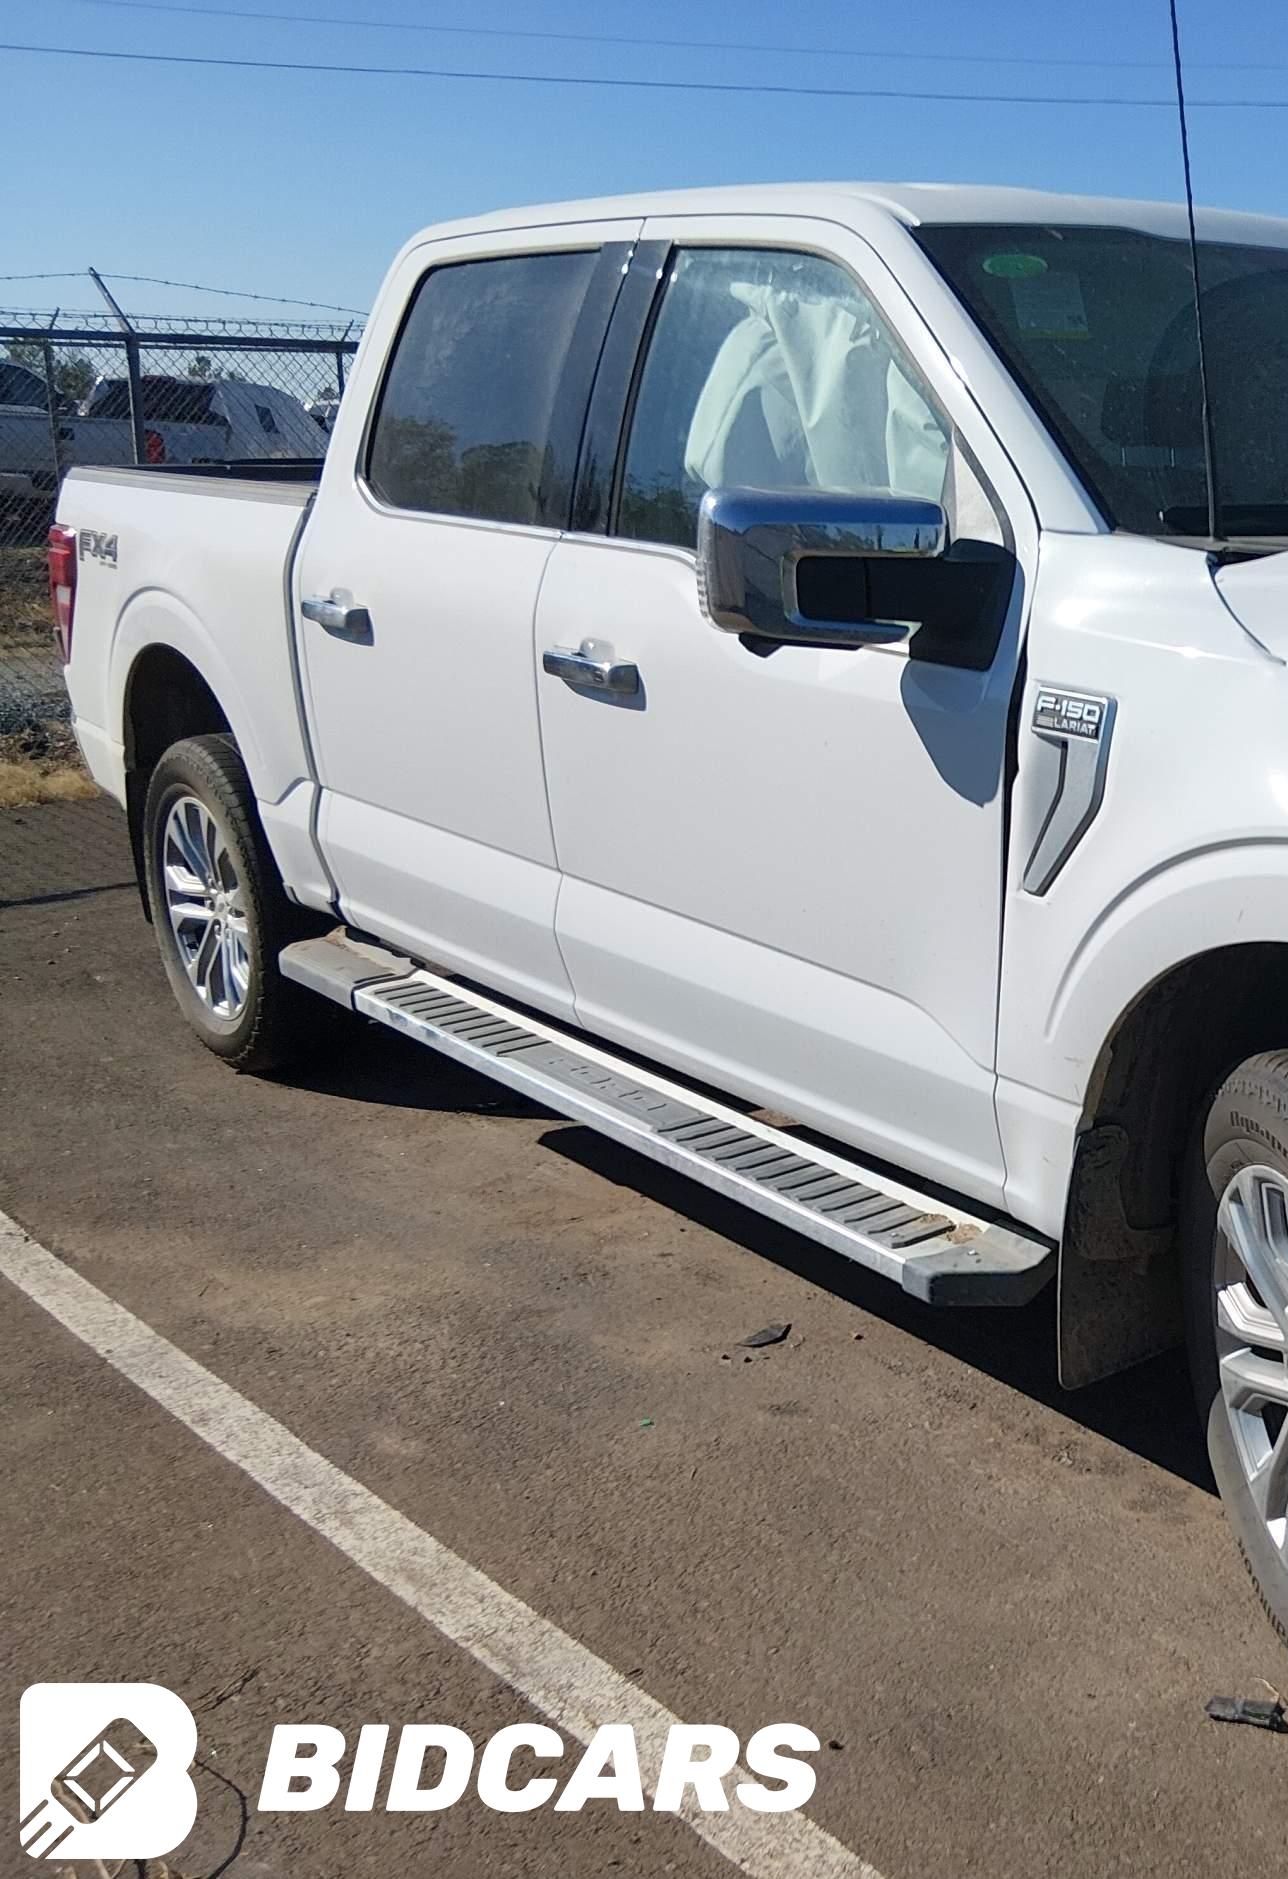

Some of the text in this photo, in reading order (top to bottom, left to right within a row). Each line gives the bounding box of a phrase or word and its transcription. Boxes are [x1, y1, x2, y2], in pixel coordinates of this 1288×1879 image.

[79, 528, 118, 562] FX4
[1036, 695, 1101, 724] F-150
[1053, 716, 1097, 737] LARIAT
